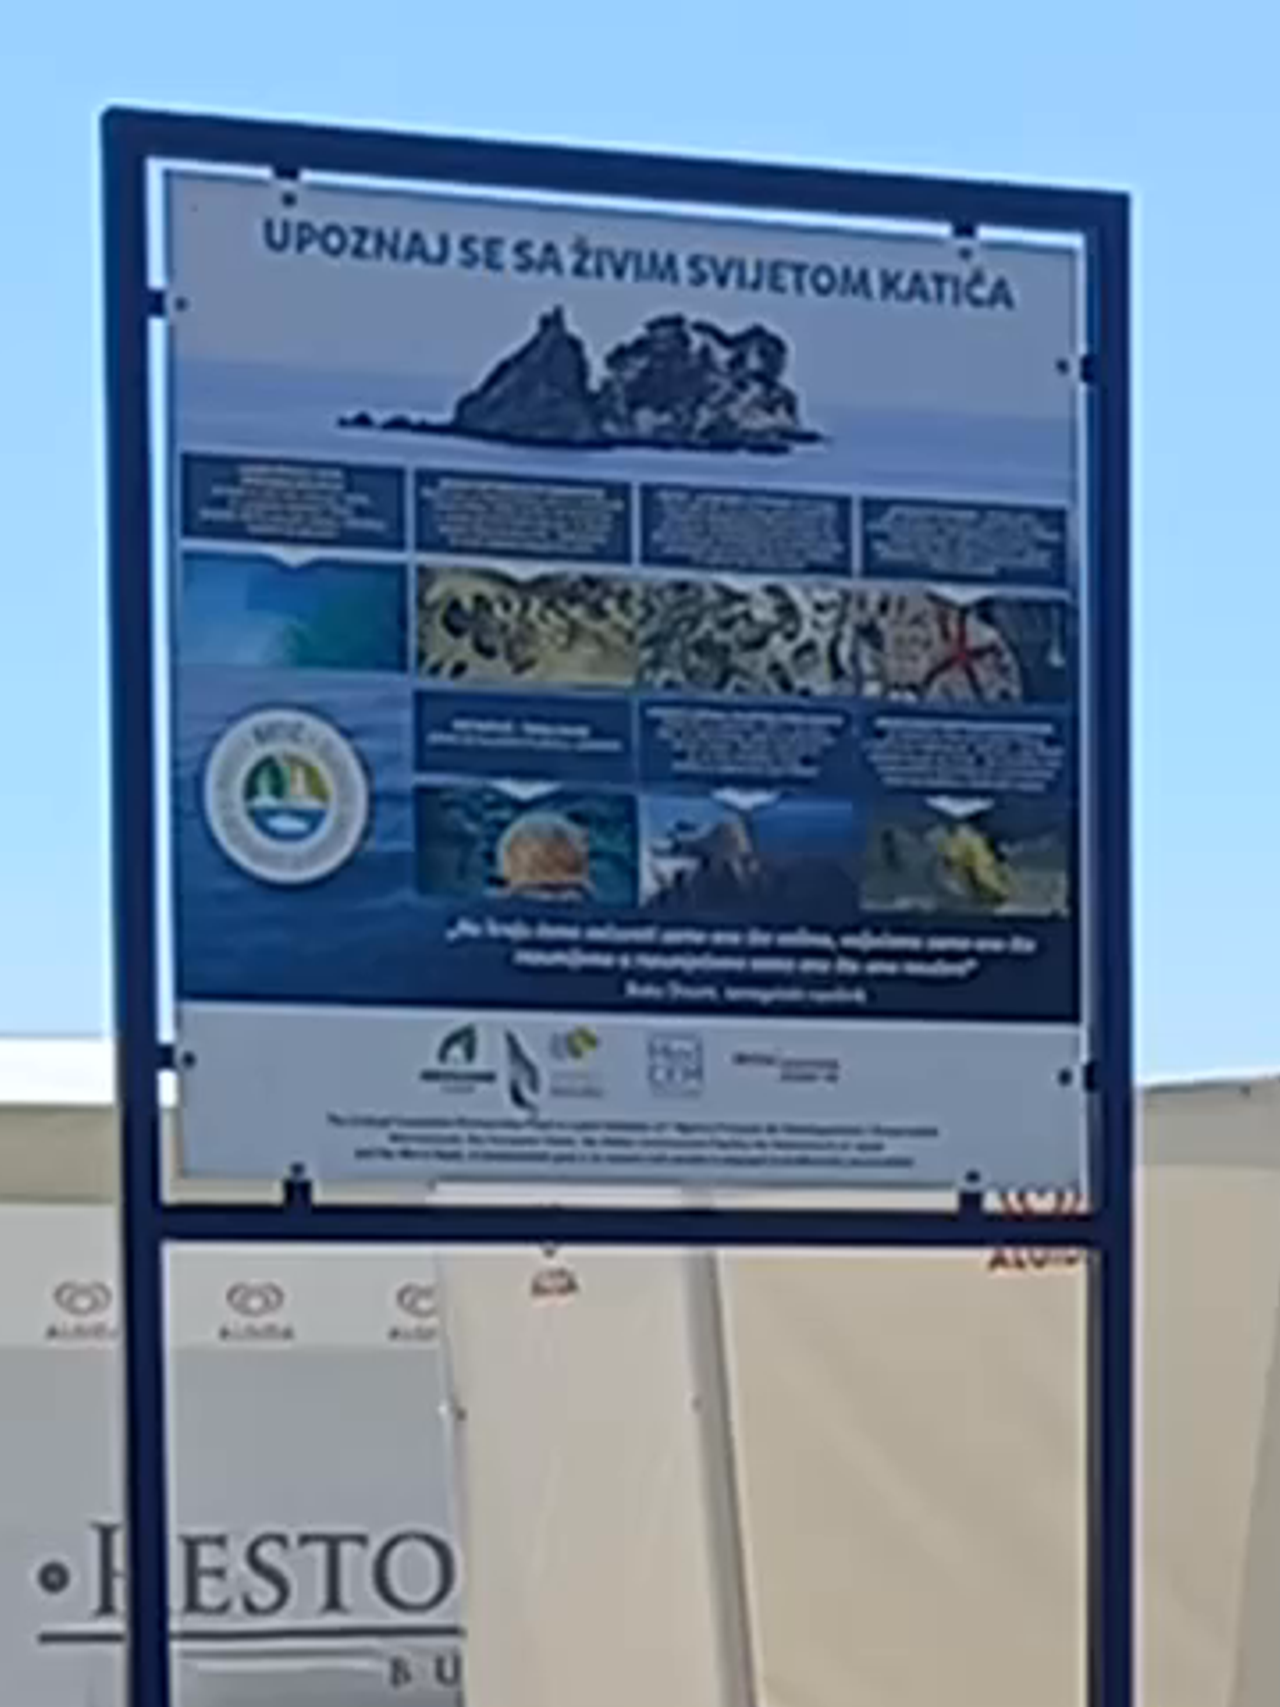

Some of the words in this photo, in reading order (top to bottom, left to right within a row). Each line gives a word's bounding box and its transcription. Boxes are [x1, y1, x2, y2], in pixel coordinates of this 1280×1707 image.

[263, 217, 450, 267] UPOZNAJ
[457, 234, 505, 272] SE
[513, 239, 565, 277] SA
[571, 234, 680, 286] ŽIVIM
[686, 253, 874, 303] SVIJETOM
